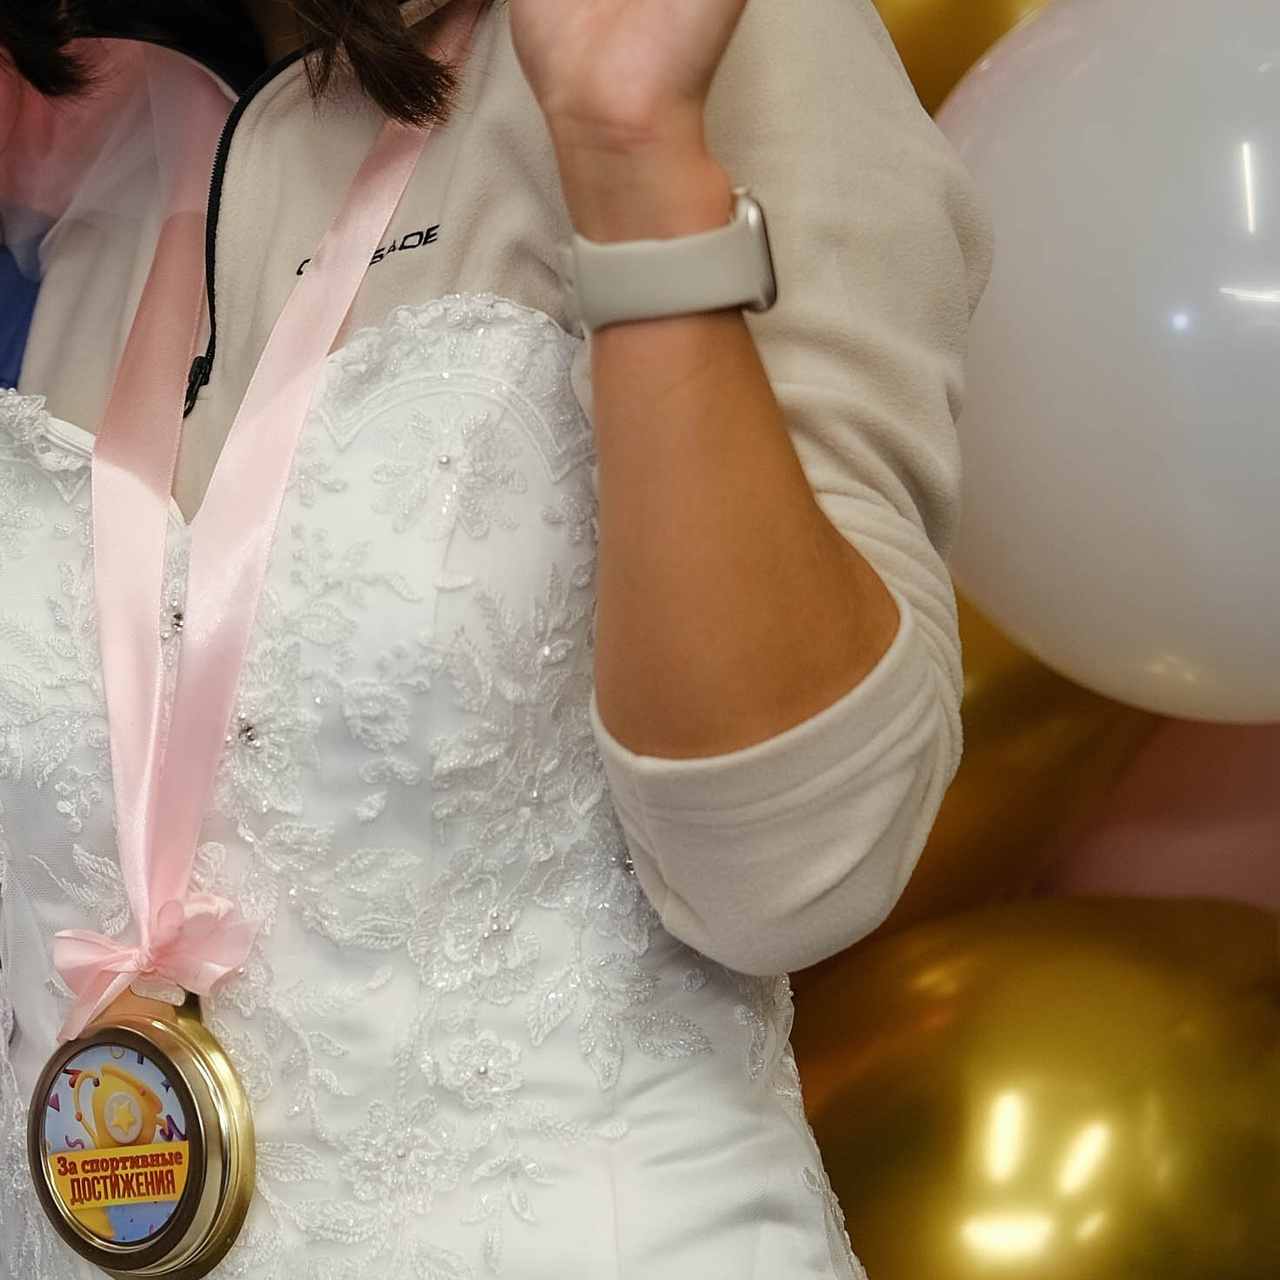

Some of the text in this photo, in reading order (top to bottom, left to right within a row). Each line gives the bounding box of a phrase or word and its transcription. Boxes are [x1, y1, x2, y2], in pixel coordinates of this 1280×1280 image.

[57, 1151, 183, 1176] За спортивные
[70, 1169, 176, 1205] ДОСТИЖЕНИЯ
